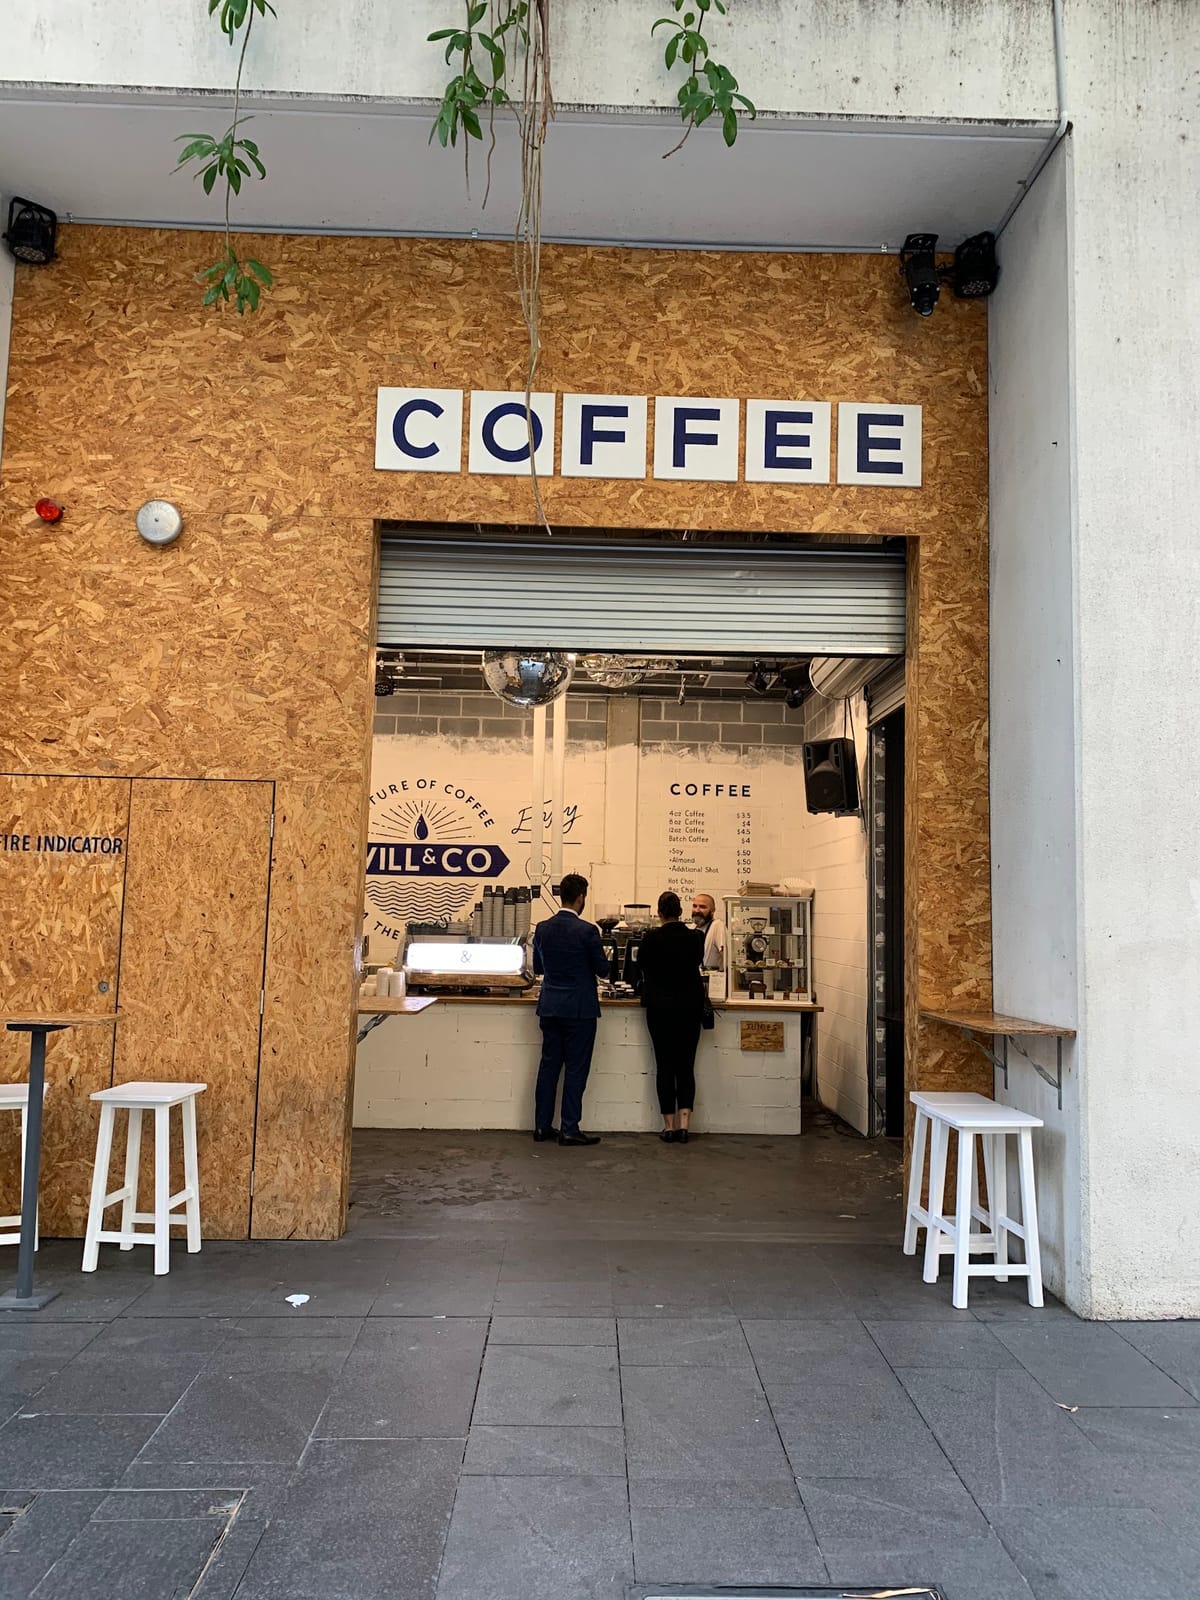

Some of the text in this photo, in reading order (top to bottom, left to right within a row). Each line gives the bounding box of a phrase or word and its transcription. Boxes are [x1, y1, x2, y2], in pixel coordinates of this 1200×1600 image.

[392, 398, 904, 474] COFFEE
[670, 783, 751, 797] COFFEE
[416, 778, 437, 790] OF
[444, 783, 495, 828] COFFEE
[685, 809, 705, 817] Coffee
[685, 826, 705, 834] Coffee
[37, 835, 123, 854] INDICATOR
[688, 835, 709, 843] Coffee
[373, 920, 401, 940] THE
